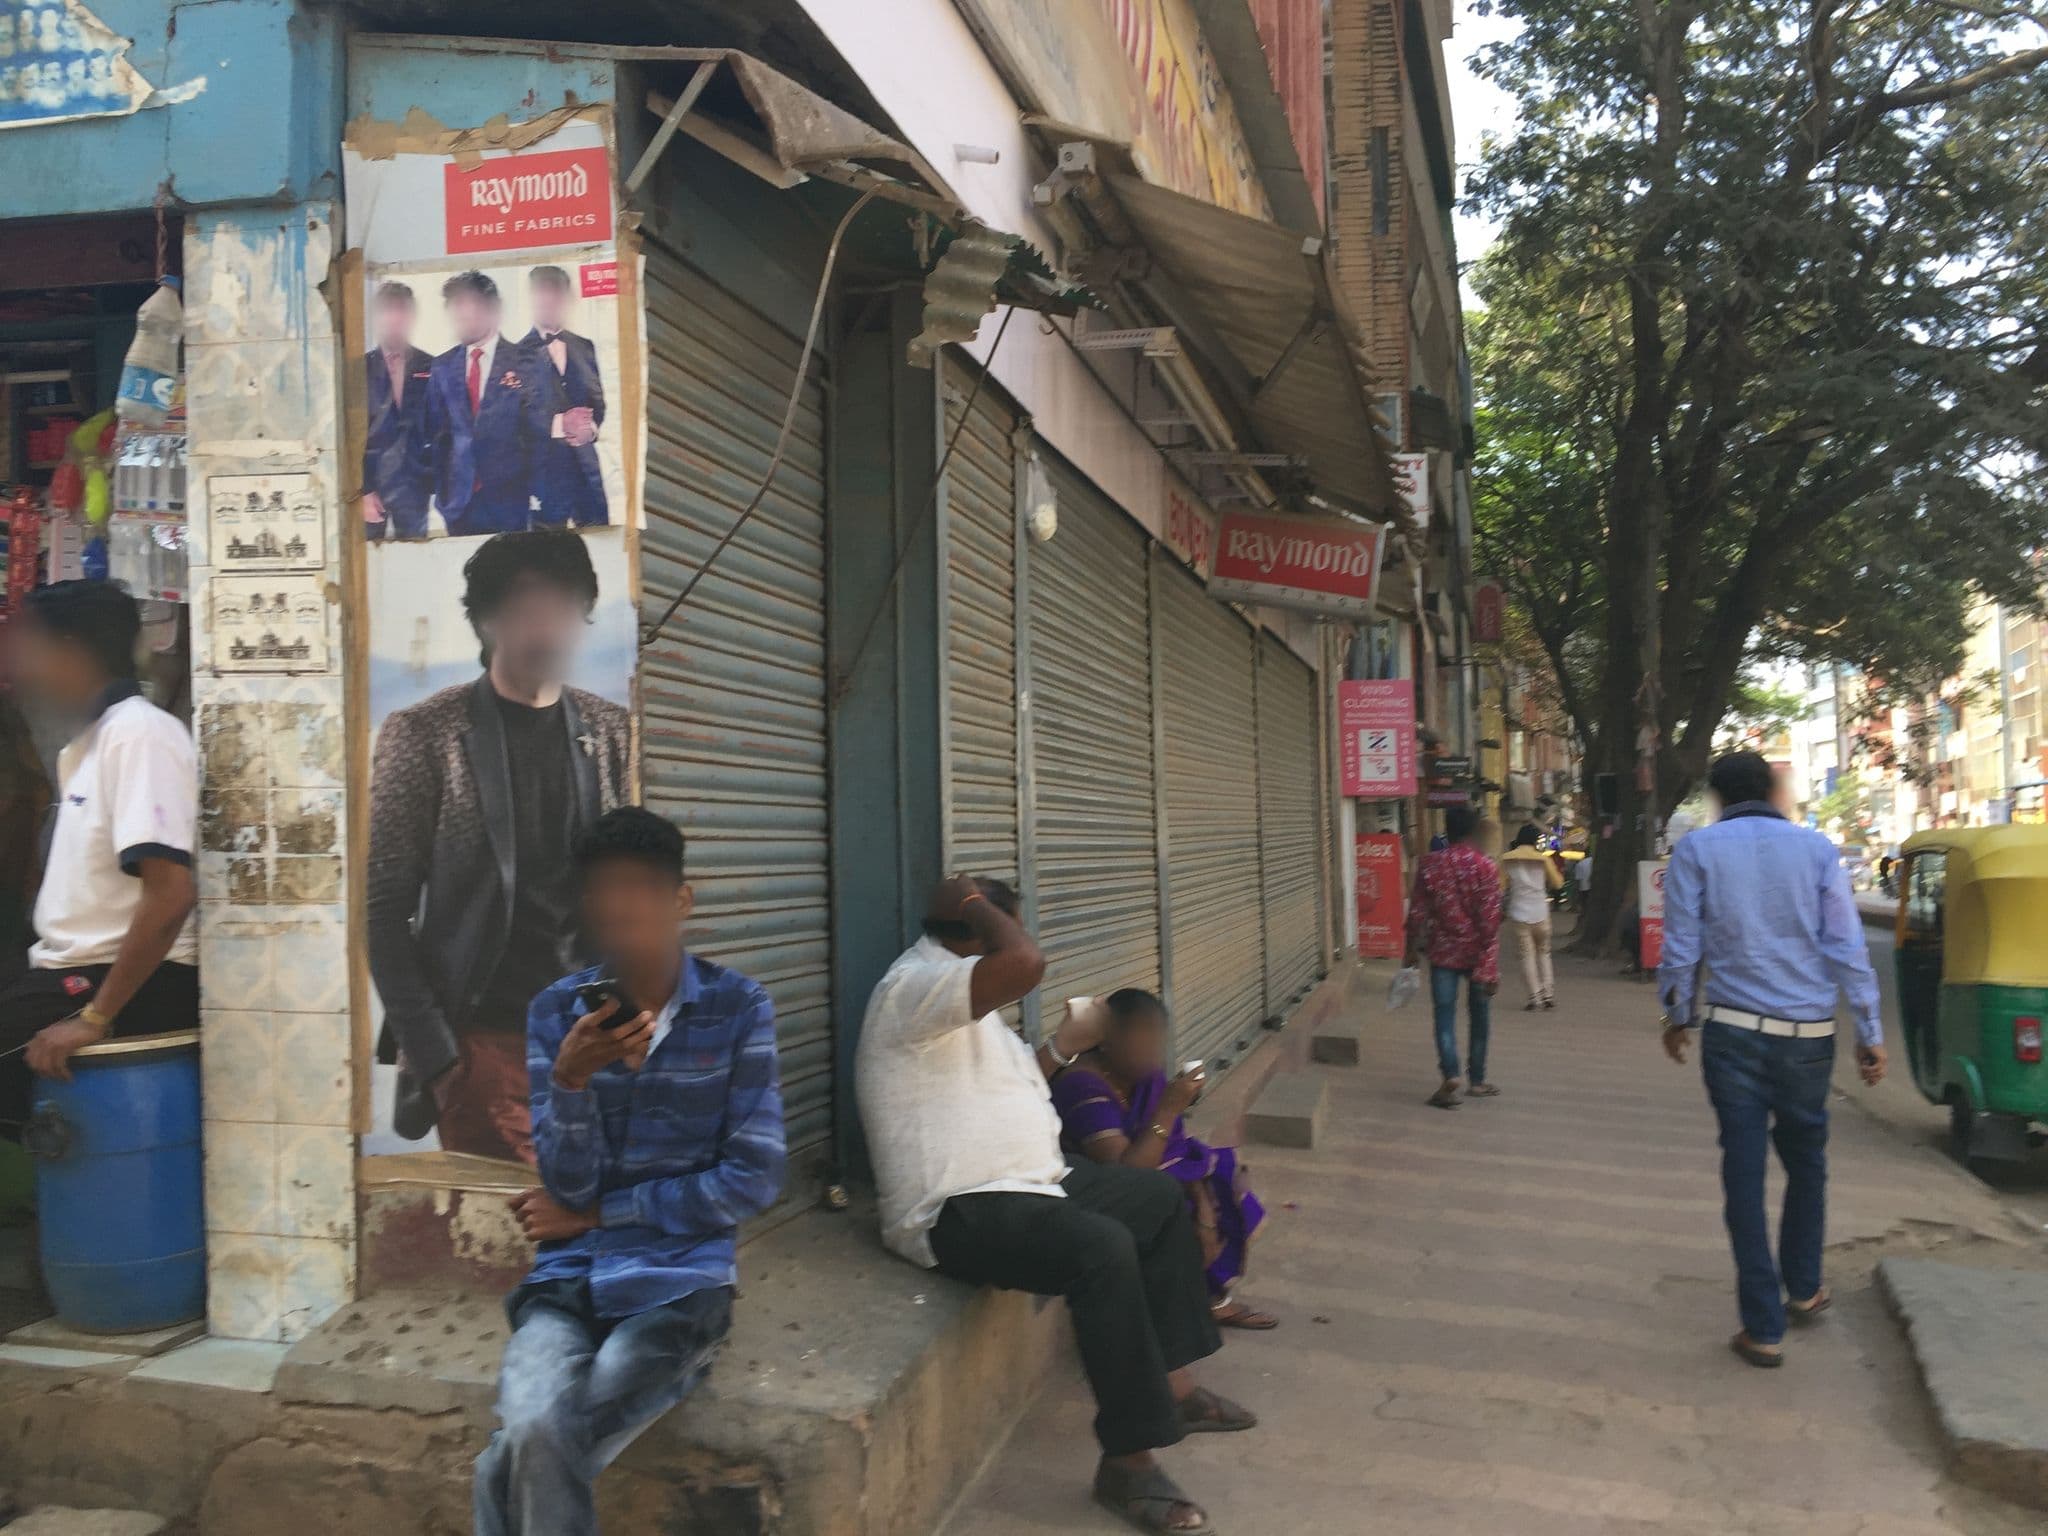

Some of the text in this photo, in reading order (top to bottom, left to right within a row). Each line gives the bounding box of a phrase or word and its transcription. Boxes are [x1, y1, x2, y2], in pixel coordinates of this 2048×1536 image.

[471, 164, 587, 213] Raymond
[461, 213, 597, 237] FINE FABRICS
[1228, 528, 1370, 577] Raymond
